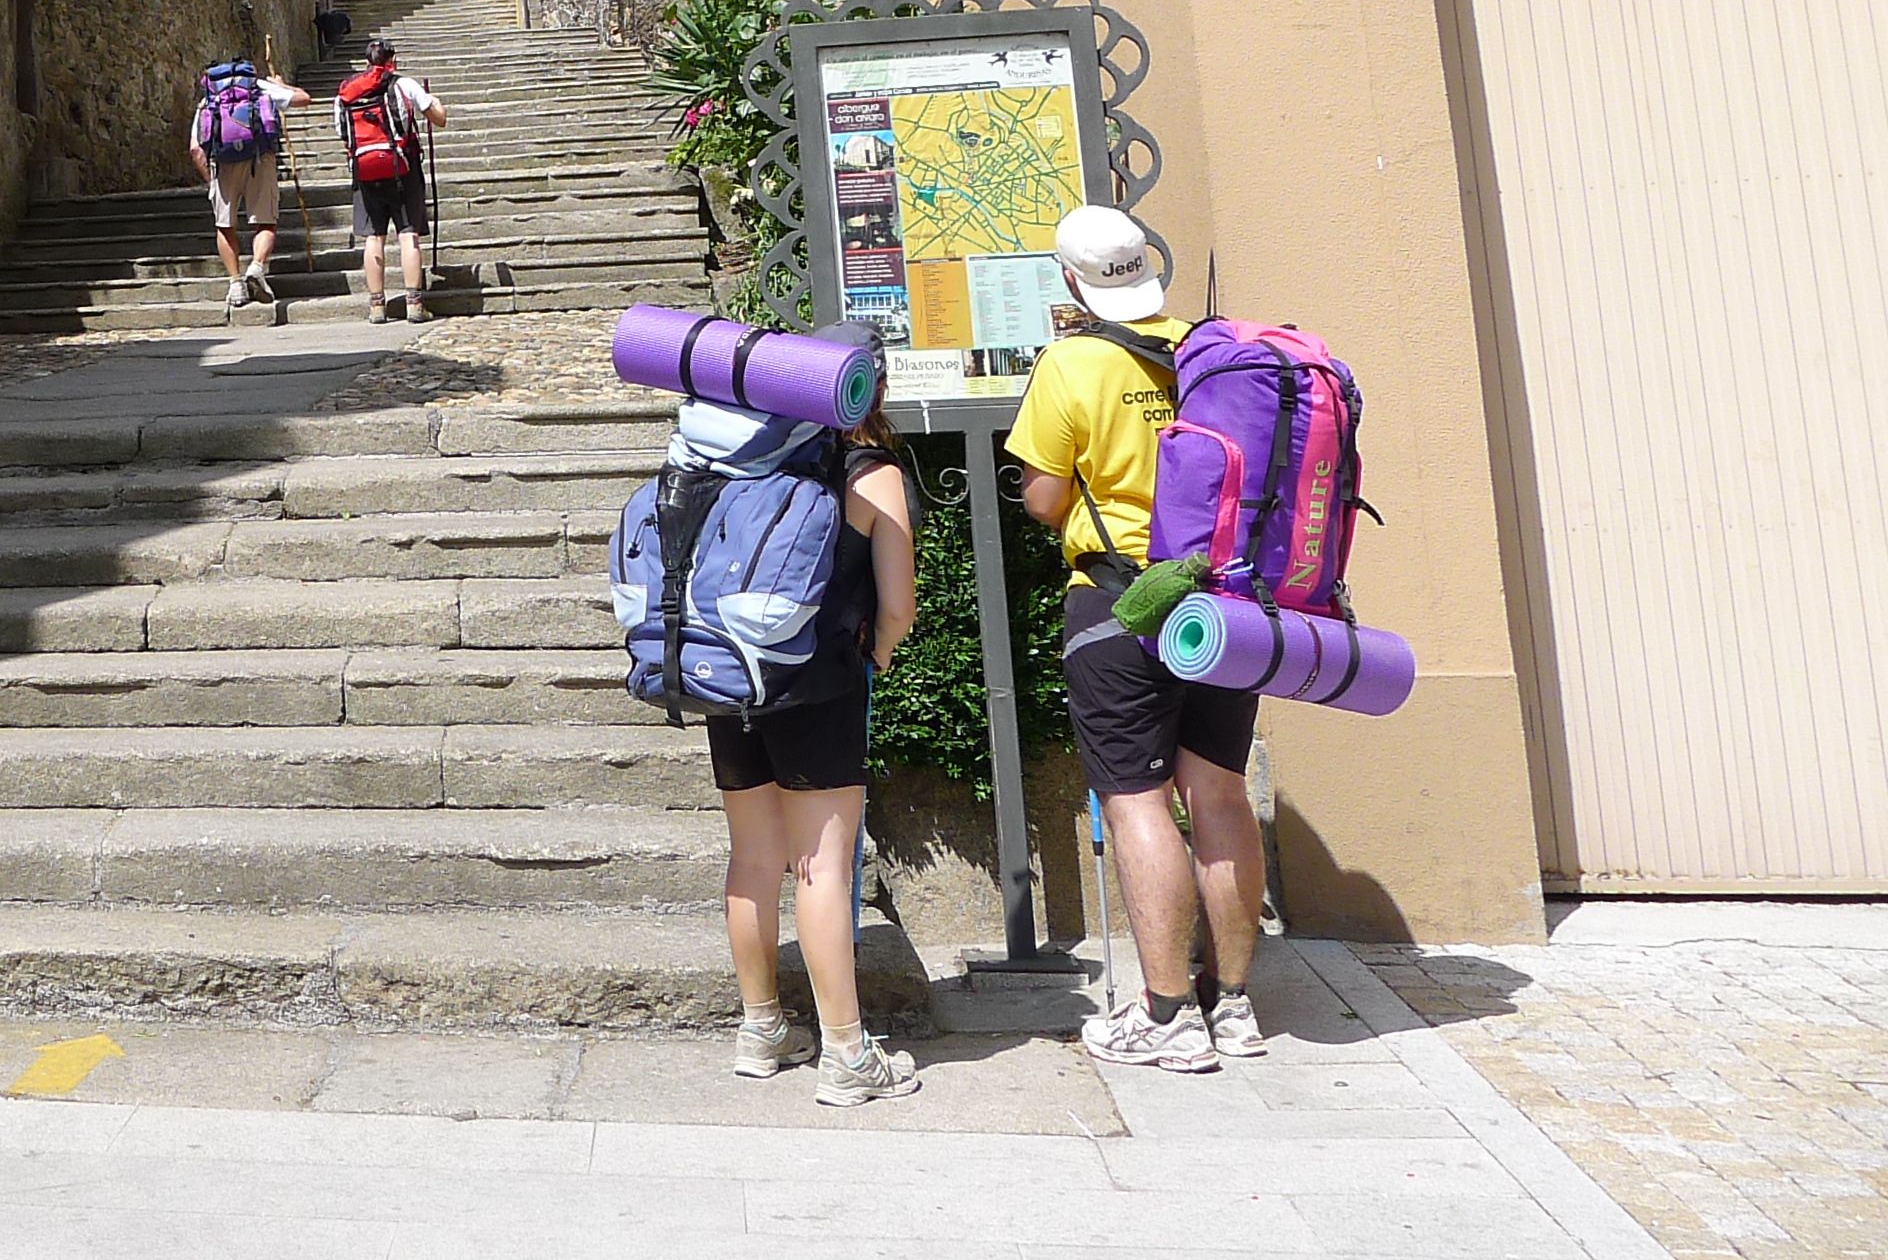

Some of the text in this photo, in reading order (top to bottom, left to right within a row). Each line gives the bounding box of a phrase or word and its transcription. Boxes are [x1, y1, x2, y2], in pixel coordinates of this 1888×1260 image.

[1101, 255, 1143, 278] Jeep
[894, 356, 960, 371] Blasones
[1285, 459, 1332, 591] Nature
